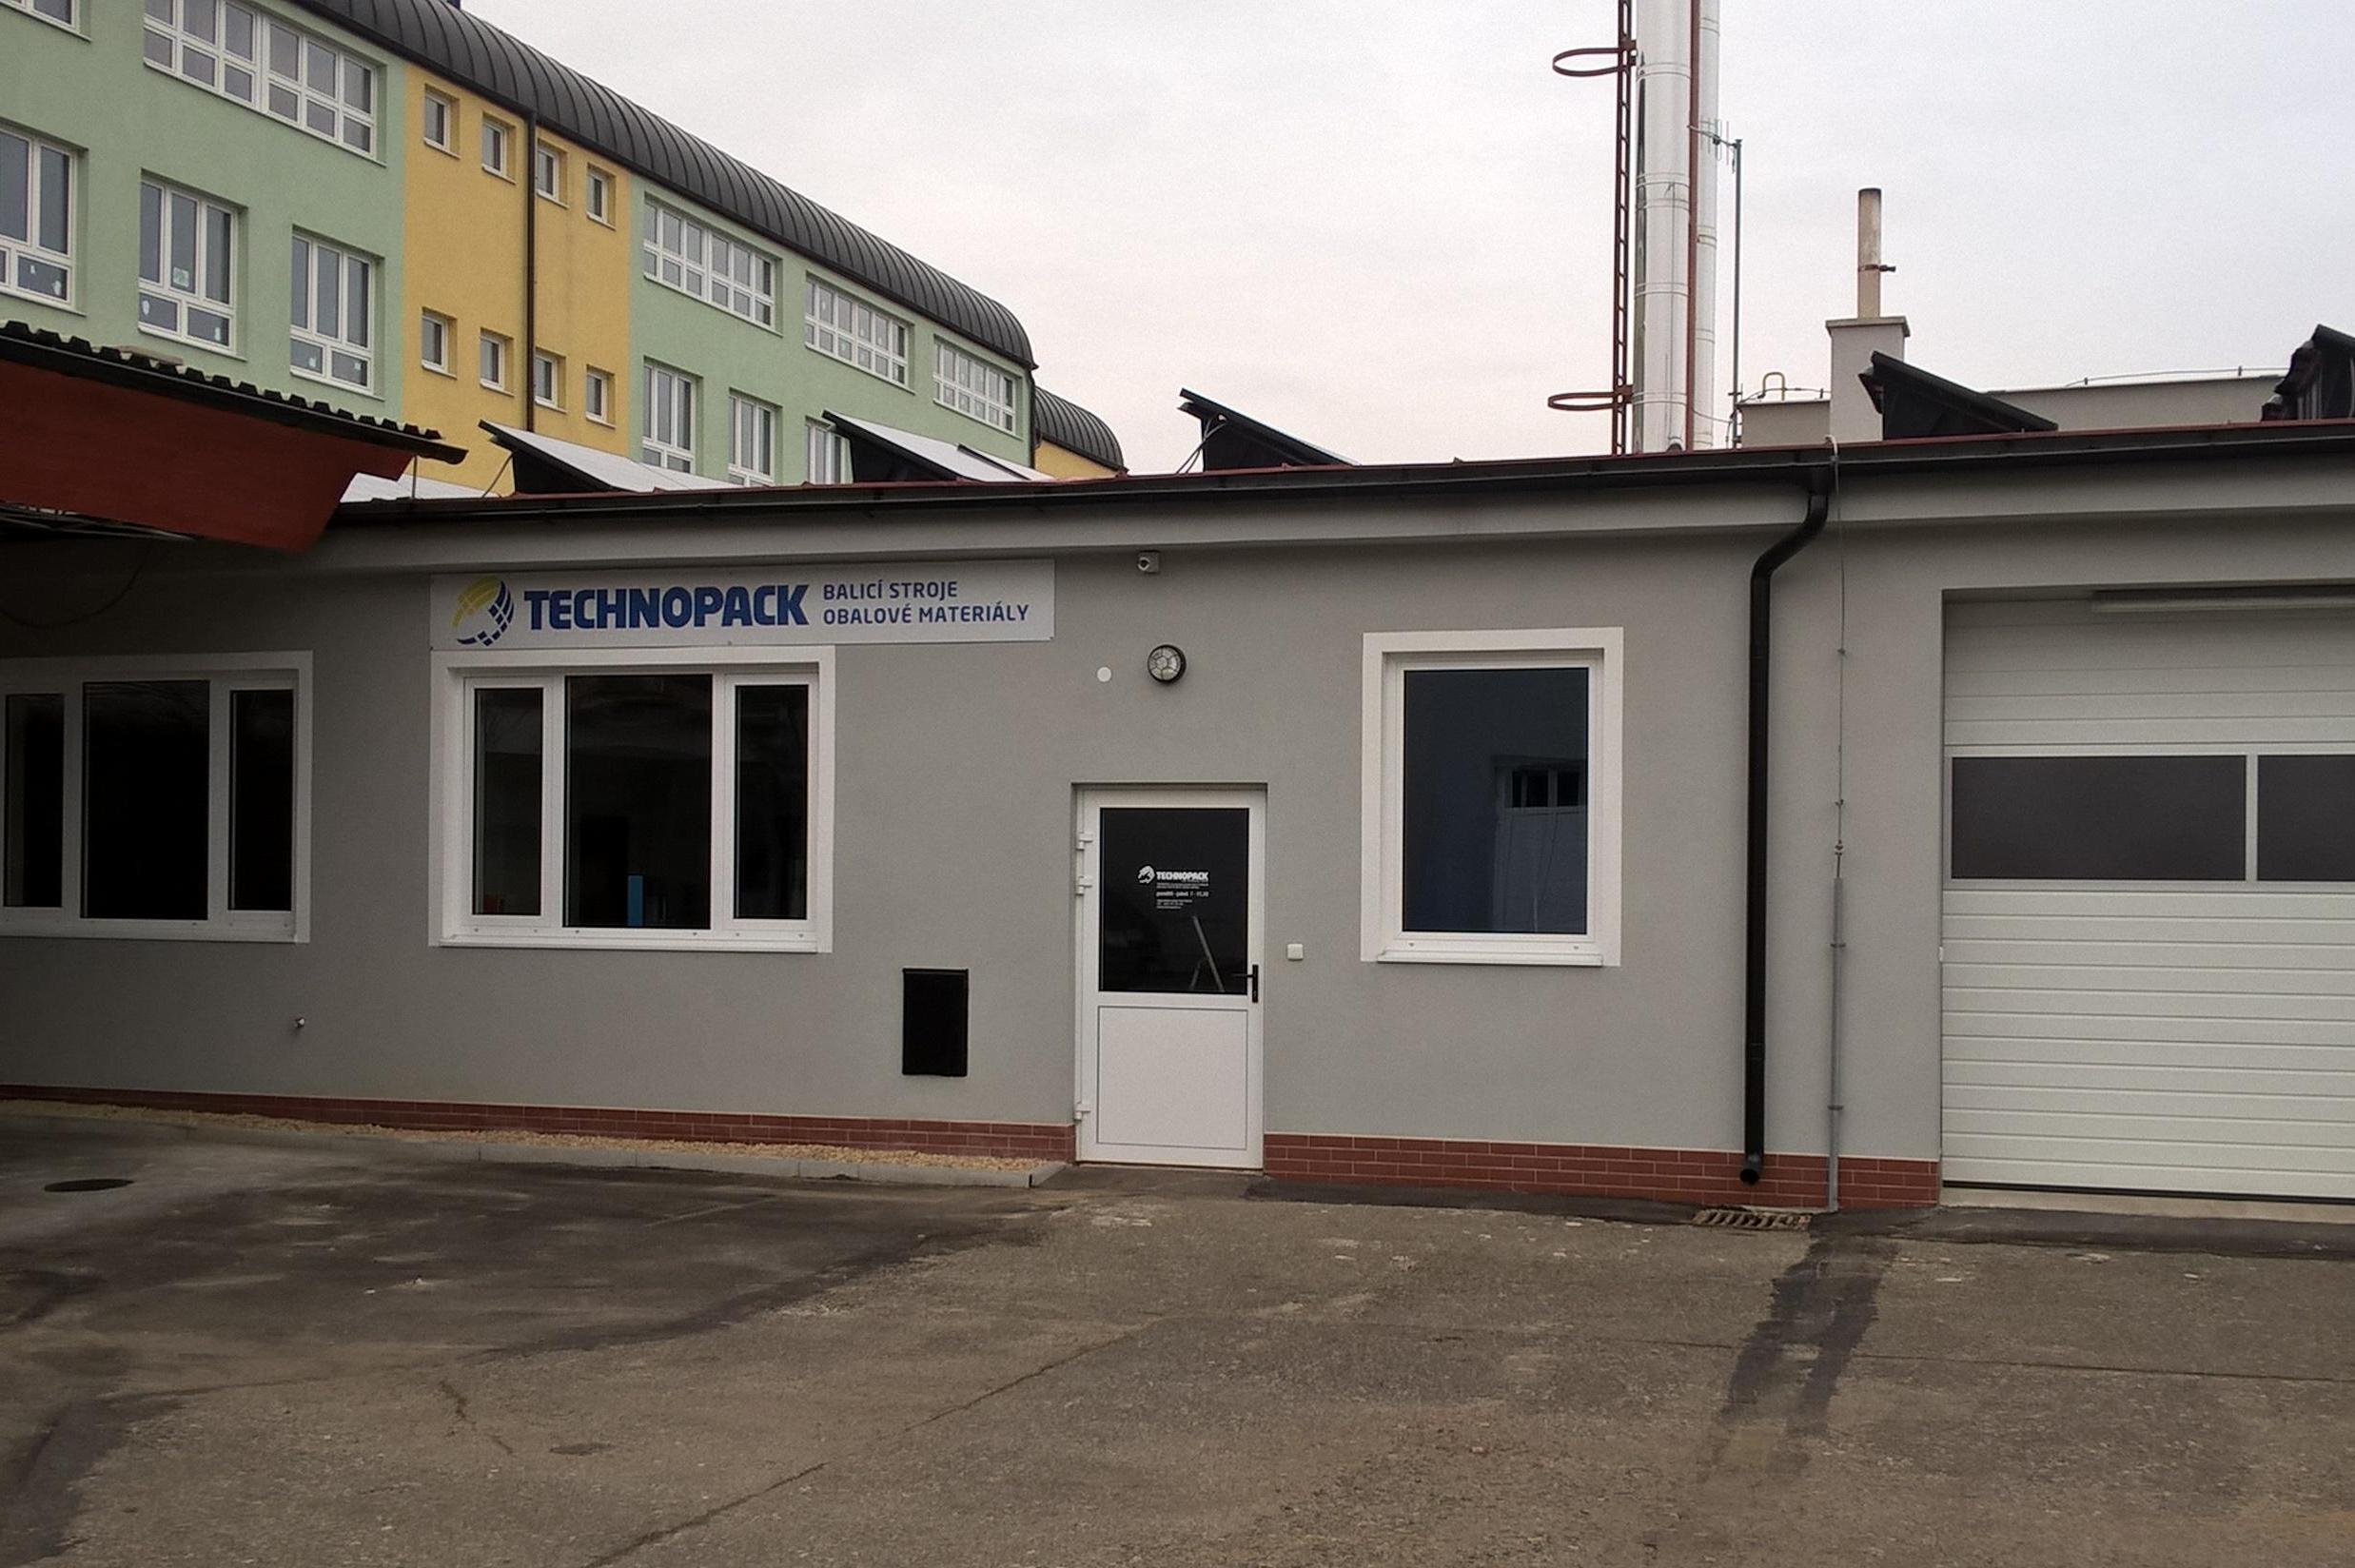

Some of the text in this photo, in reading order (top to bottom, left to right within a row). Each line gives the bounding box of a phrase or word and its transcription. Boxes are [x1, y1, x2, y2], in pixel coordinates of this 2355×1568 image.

[823, 579, 957, 601] BALICÍ STROJE
[523, 584, 810, 630] TECHNOPACK
[823, 601, 1030, 625] OBALOVÉ MATERIÁLY
[1156, 871, 1209, 881] TECHNOPACK
